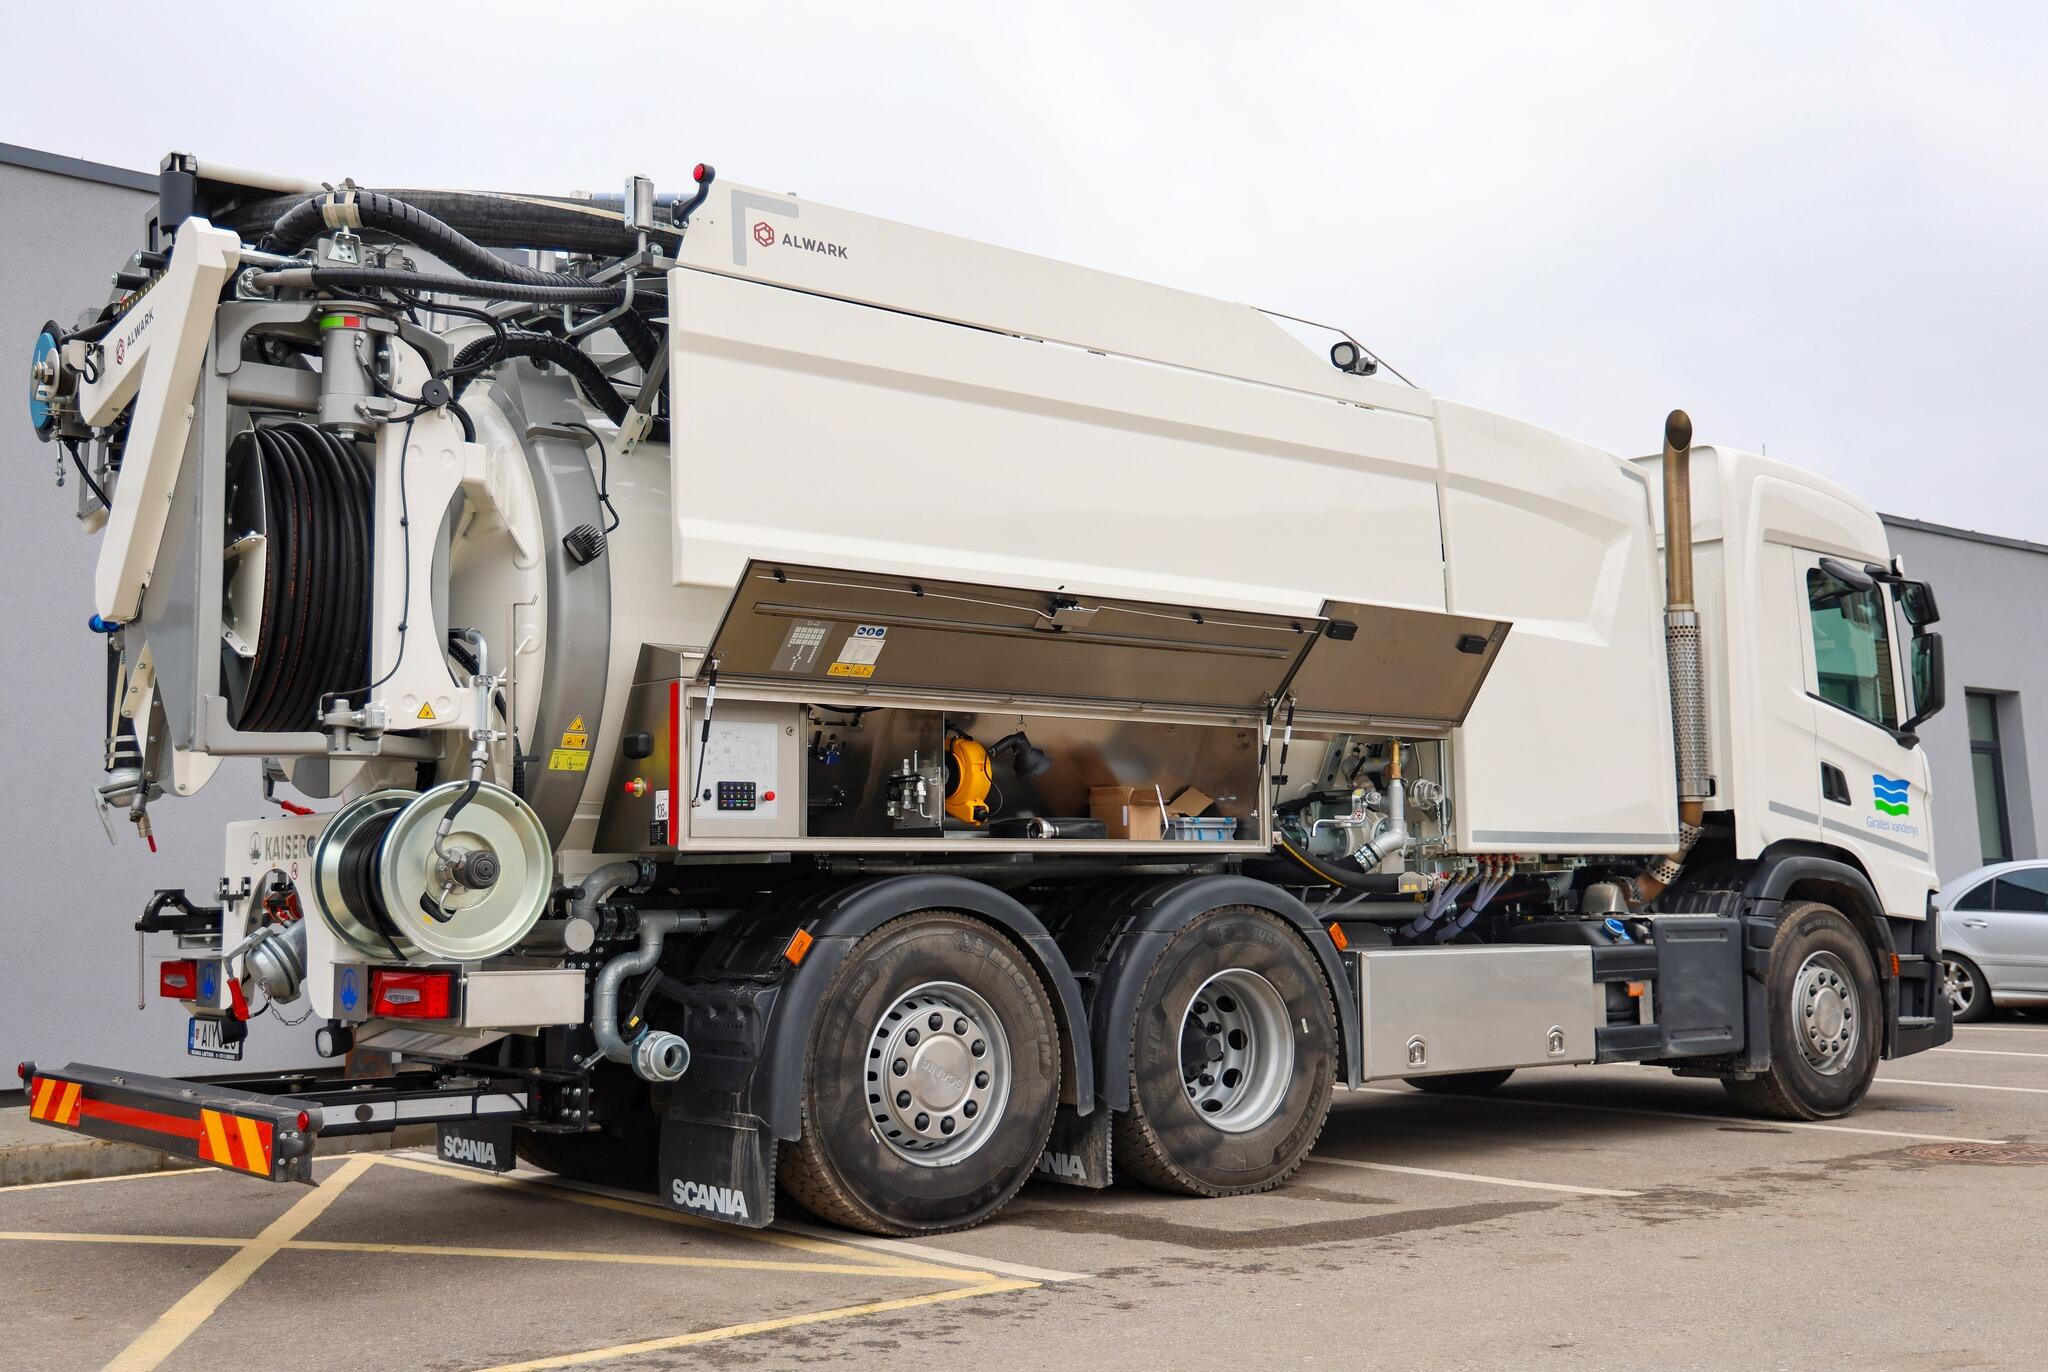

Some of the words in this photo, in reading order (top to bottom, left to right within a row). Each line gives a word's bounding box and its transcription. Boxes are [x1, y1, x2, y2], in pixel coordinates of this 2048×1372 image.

[782, 233, 848, 260] ALWARK
[127, 306, 154, 349] ALWARK
[265, 834, 307, 861] KAISER
[444, 1135, 497, 1165] SCANIA
[672, 1178, 749, 1218] SCANIA
